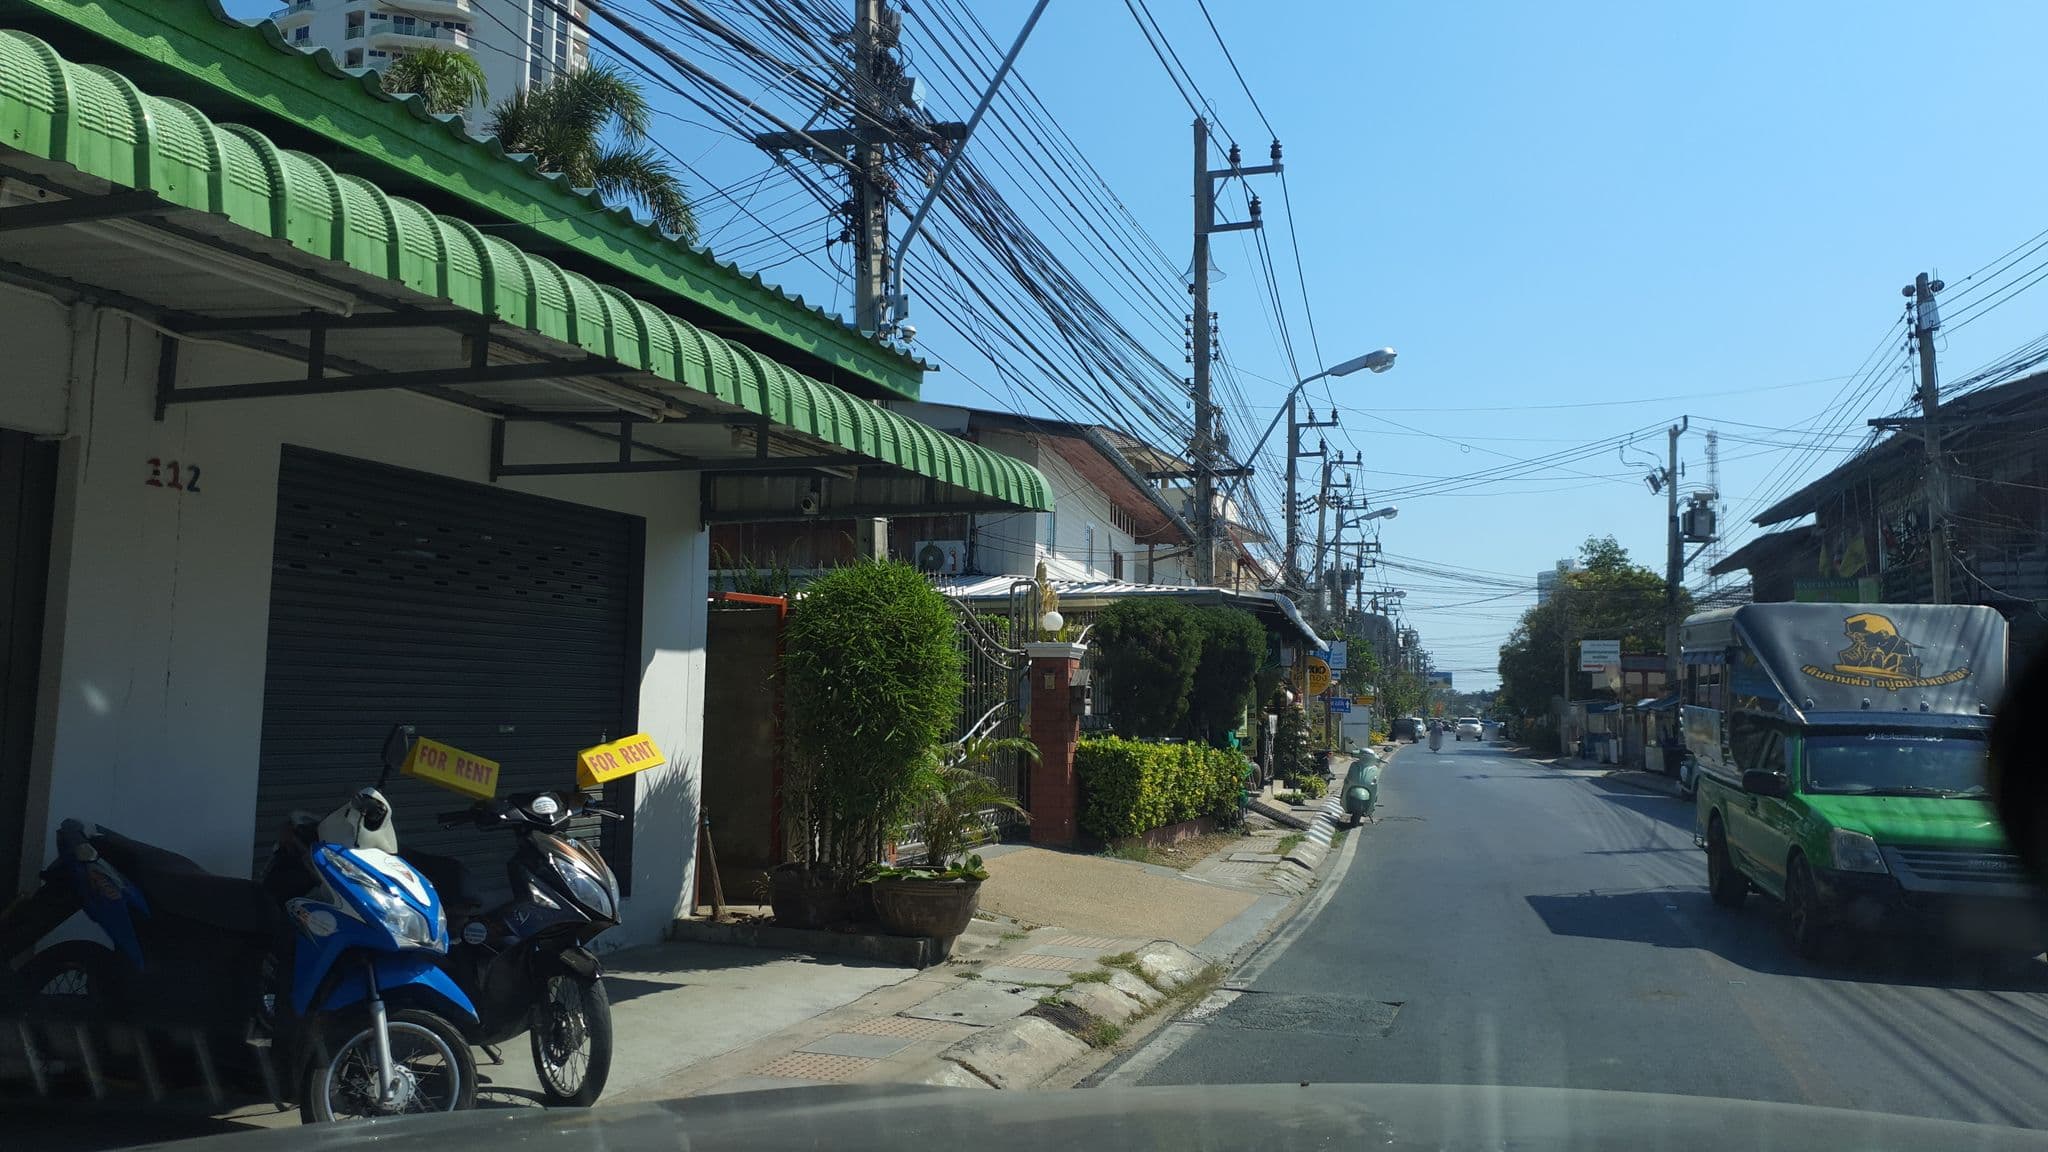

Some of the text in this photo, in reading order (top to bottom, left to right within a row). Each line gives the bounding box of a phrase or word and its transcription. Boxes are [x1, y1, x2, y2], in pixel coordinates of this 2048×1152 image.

[419, 745, 493, 785] FOR RENT
[589, 741, 656, 774] FOR RENT
